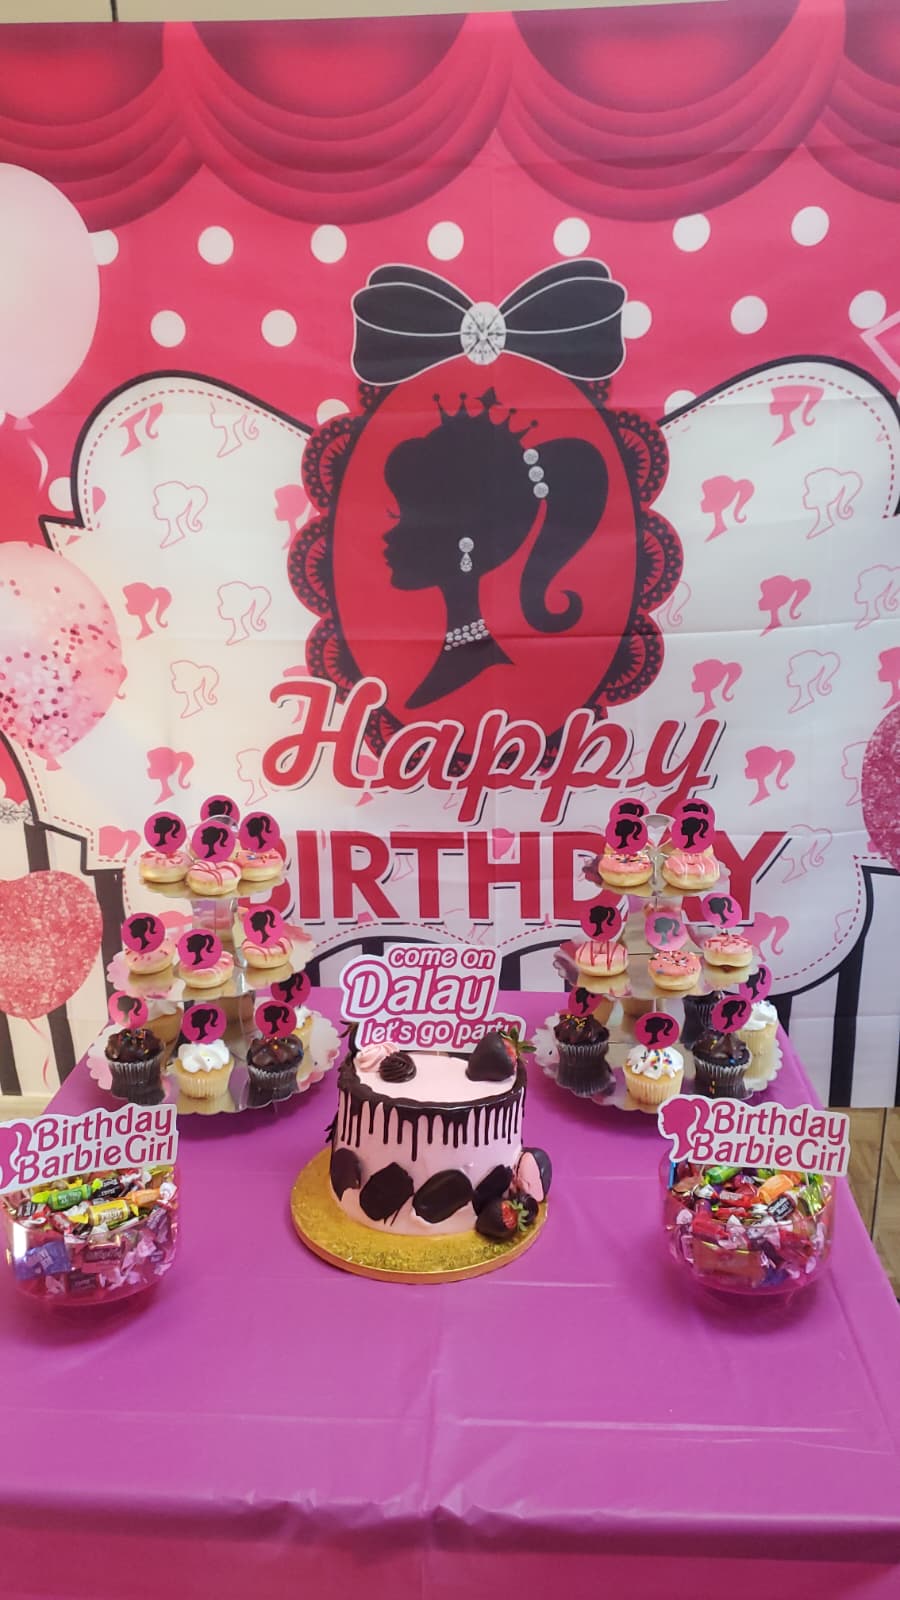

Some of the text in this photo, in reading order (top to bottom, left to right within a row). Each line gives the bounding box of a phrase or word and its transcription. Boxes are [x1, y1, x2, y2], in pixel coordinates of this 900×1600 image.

[262, 680, 720, 823] Happy
[389, 947, 495, 969] come on
[344, 960, 495, 1021] Dalay
[363, 1020, 414, 1046] let's
[418, 1022, 452, 1047] go
[33, 1106, 173, 1152] Birthday
[711, 1100, 847, 1146] Birthday
